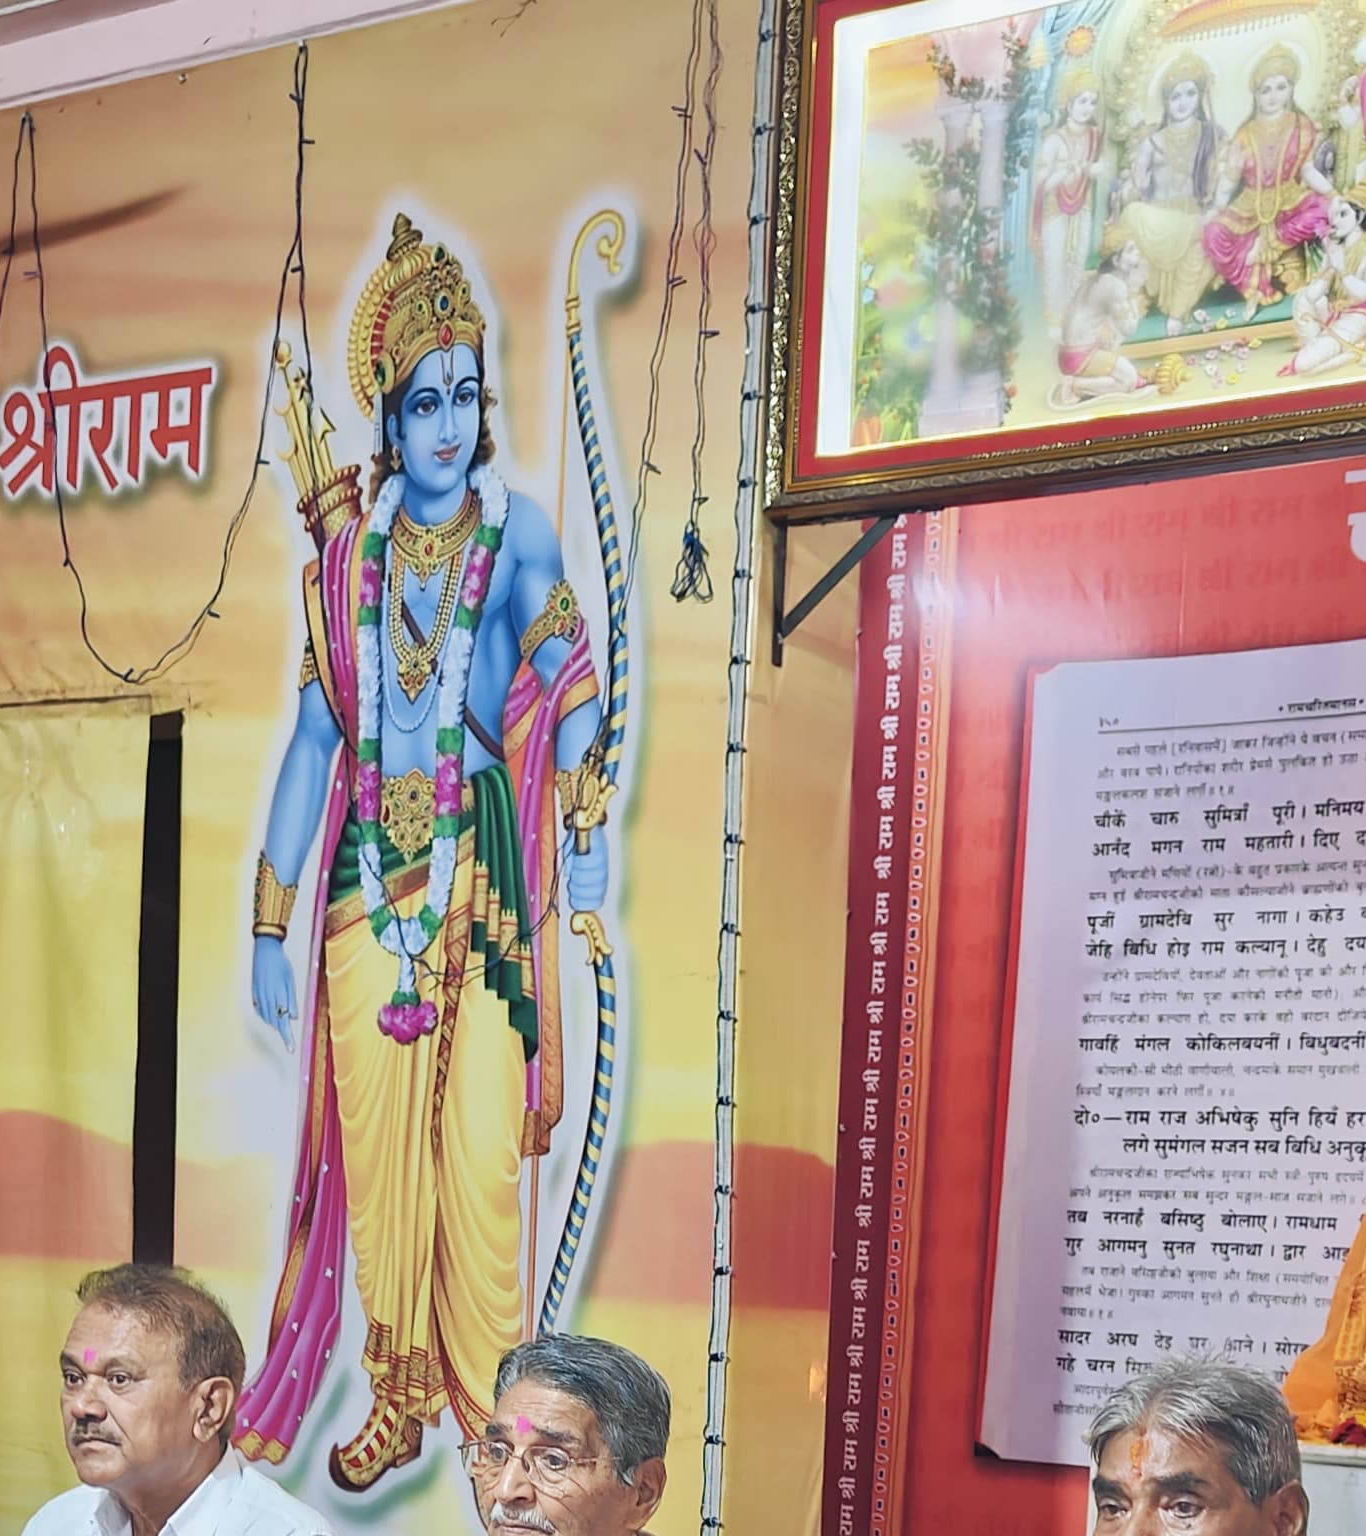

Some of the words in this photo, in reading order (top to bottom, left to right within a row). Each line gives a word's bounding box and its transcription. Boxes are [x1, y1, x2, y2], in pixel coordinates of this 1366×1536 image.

[1315, 797, 1365, 817] मनिमय
[1151, 839, 1183, 854] मगन
[1201, 837, 1227, 852] राम
[1313, 828, 1340, 850] दिए
[1213, 911, 1235, 932] सुर
[1308, 903, 1346, 924] कहेउ
[1085, 938, 1113, 959] जेहि
[1166, 936, 1190, 958] होइ
[1200, 940, 1225, 955] राम
[1306, 933, 1327, 957] देहु
[1135, 1034, 1171, 1052] मंगल
[1158, 1110, 1187, 1126] राज
[1268, 1106, 1300, 1132] सुनि
[1122, 1133, 1150, 1153] लगे
[1153, 1134, 1206, 1159] सुमंगल
[1210, 1139, 1249, 1155] सजन
[1253, 1139, 1281, 1155] सब
[1066, 1209, 1088, 1224] तब
[1285, 1214, 1338, 1231] रामधाम
[1064, 1236, 1084, 1257] गुर
[1098, 1238, 1147, 1259] आगमनु
[1162, 1240, 1196, 1260] सुनत
[1283, 1243, 1307, 1261] द्वार
[1057, 1328, 1092, 1346] सादर
[1154, 1329, 1174, 1351] देइ
[1055, 1351, 1076, 1373] गहे
